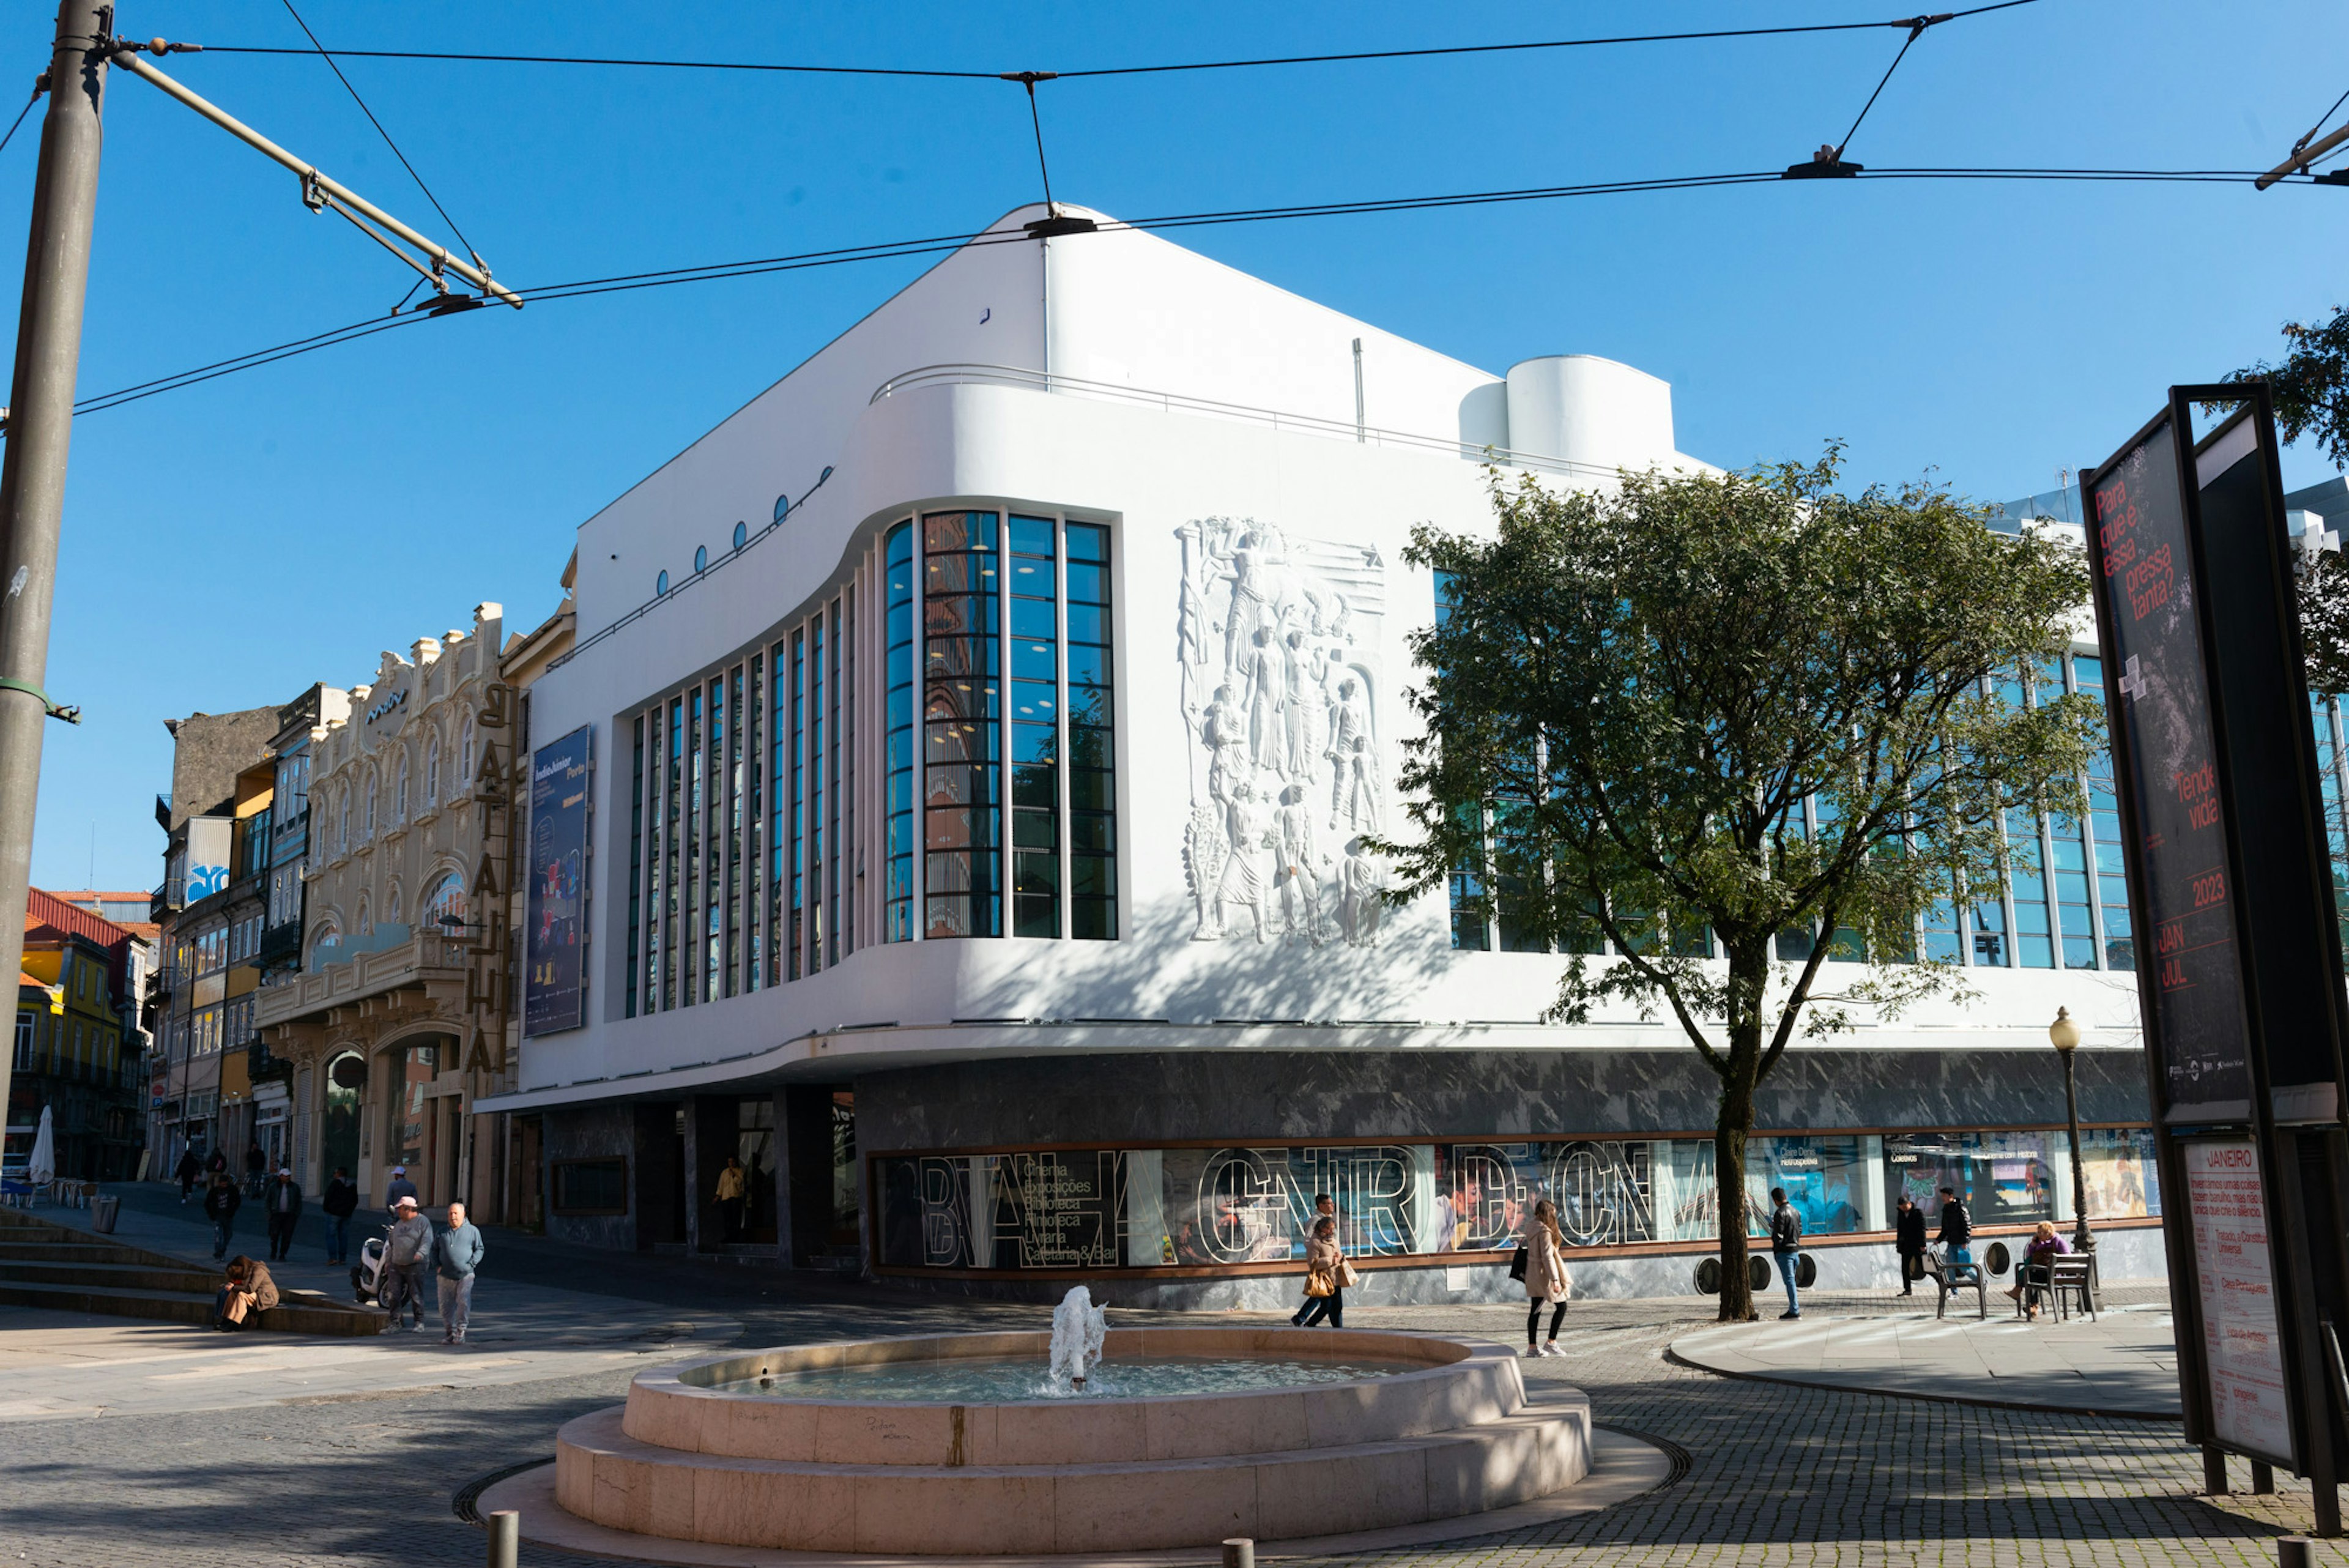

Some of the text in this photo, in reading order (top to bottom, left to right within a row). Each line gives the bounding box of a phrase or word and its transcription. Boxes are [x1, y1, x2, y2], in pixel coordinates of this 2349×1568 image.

[2095, 480, 2126, 521] Para
[2100, 498, 2137, 551] que é
[2104, 538, 2136, 577] essa
[2126, 543, 2172, 600] pressa
[2132, 567, 2173, 620] tanta?
[566, 764, 585, 780] Porto
[2189, 793, 2218, 830] vida
[2193, 873, 2225, 908] 2023
[2158, 923, 2184, 953] JAN
[2162, 961, 2187, 987] JUL
[1780, 1146, 1816, 1156] Claire Denis
[2208, 1150, 2252, 1168] JANEIRO
[1024, 1164, 1067, 1176] Cinema
[1025, 1179, 1091, 1196] Exposições
[2224, 1180, 2240, 1189] umas
[2241, 1178, 2260, 1190] coisas
[1025, 1197, 1081, 1211] Biblioteca
[2233, 1194, 2246, 1203] mas
[2247, 1192, 2259, 1204] não
[919, 1150, 1178, 1268] BATALHA
[2209, 1206, 2221, 1217] que
[1025, 1213, 1081, 1227] Filmoteca
[1025, 1229, 1066, 1244] Livraria
[1025, 1245, 1116, 1261] Cafetaria & Bar
